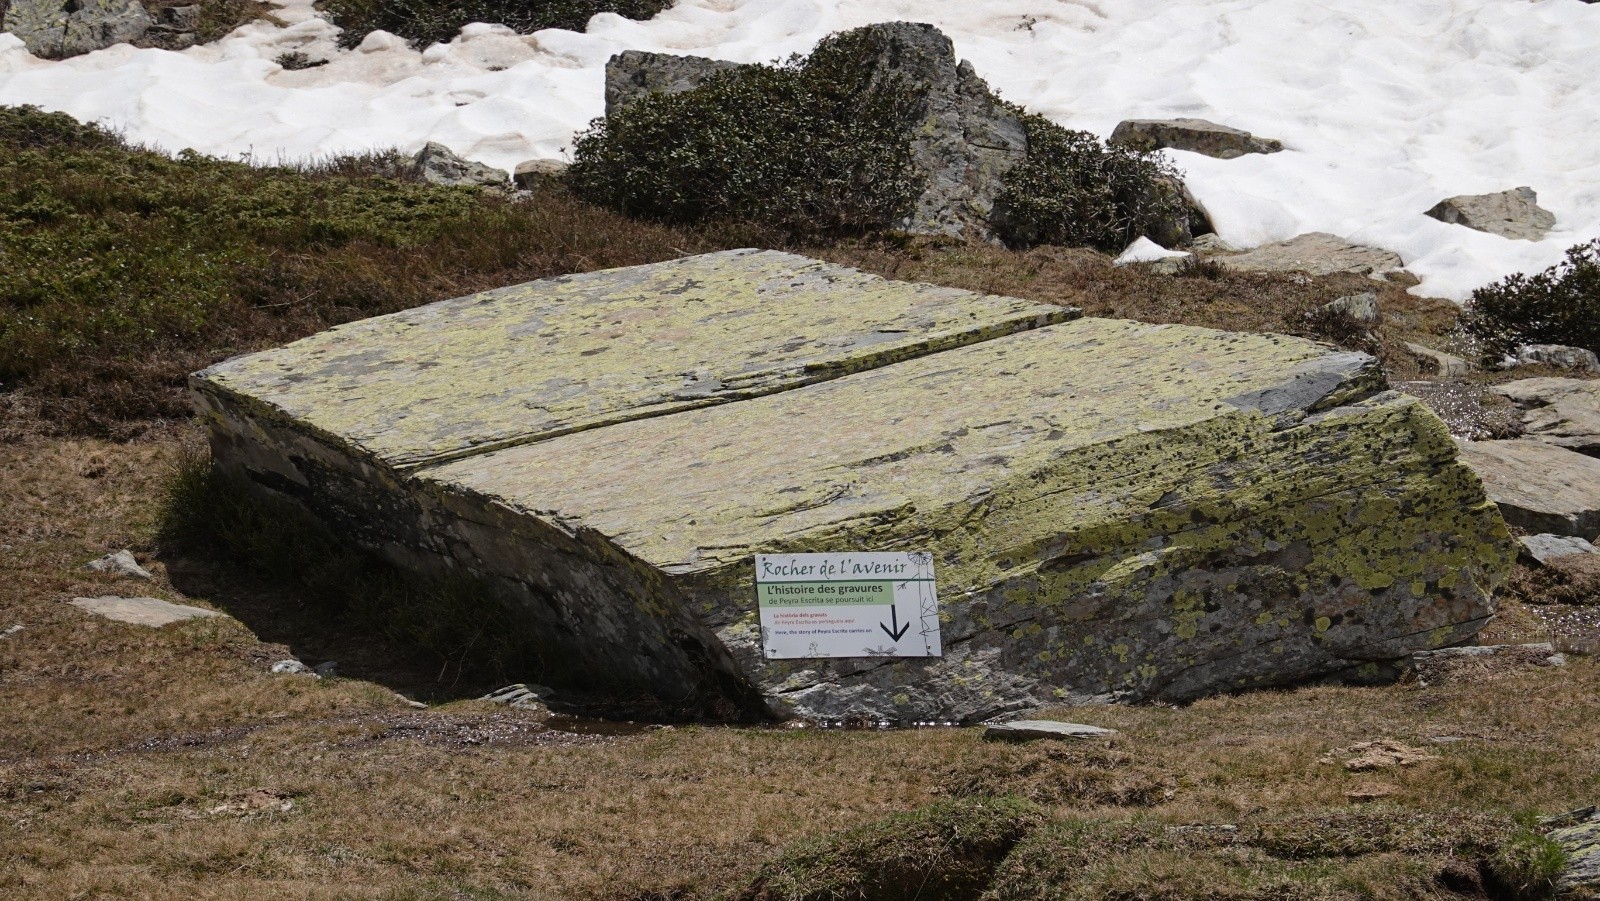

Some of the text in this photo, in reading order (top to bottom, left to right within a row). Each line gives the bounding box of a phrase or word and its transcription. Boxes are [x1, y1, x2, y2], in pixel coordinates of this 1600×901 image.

[762, 559, 815, 579] Rocher
[767, 584, 883, 595] L'histoire des gravures
[779, 597, 799, 606] Peyra
[800, 597, 824, 605] Escrita
[835, 596, 864, 604] poursuit
